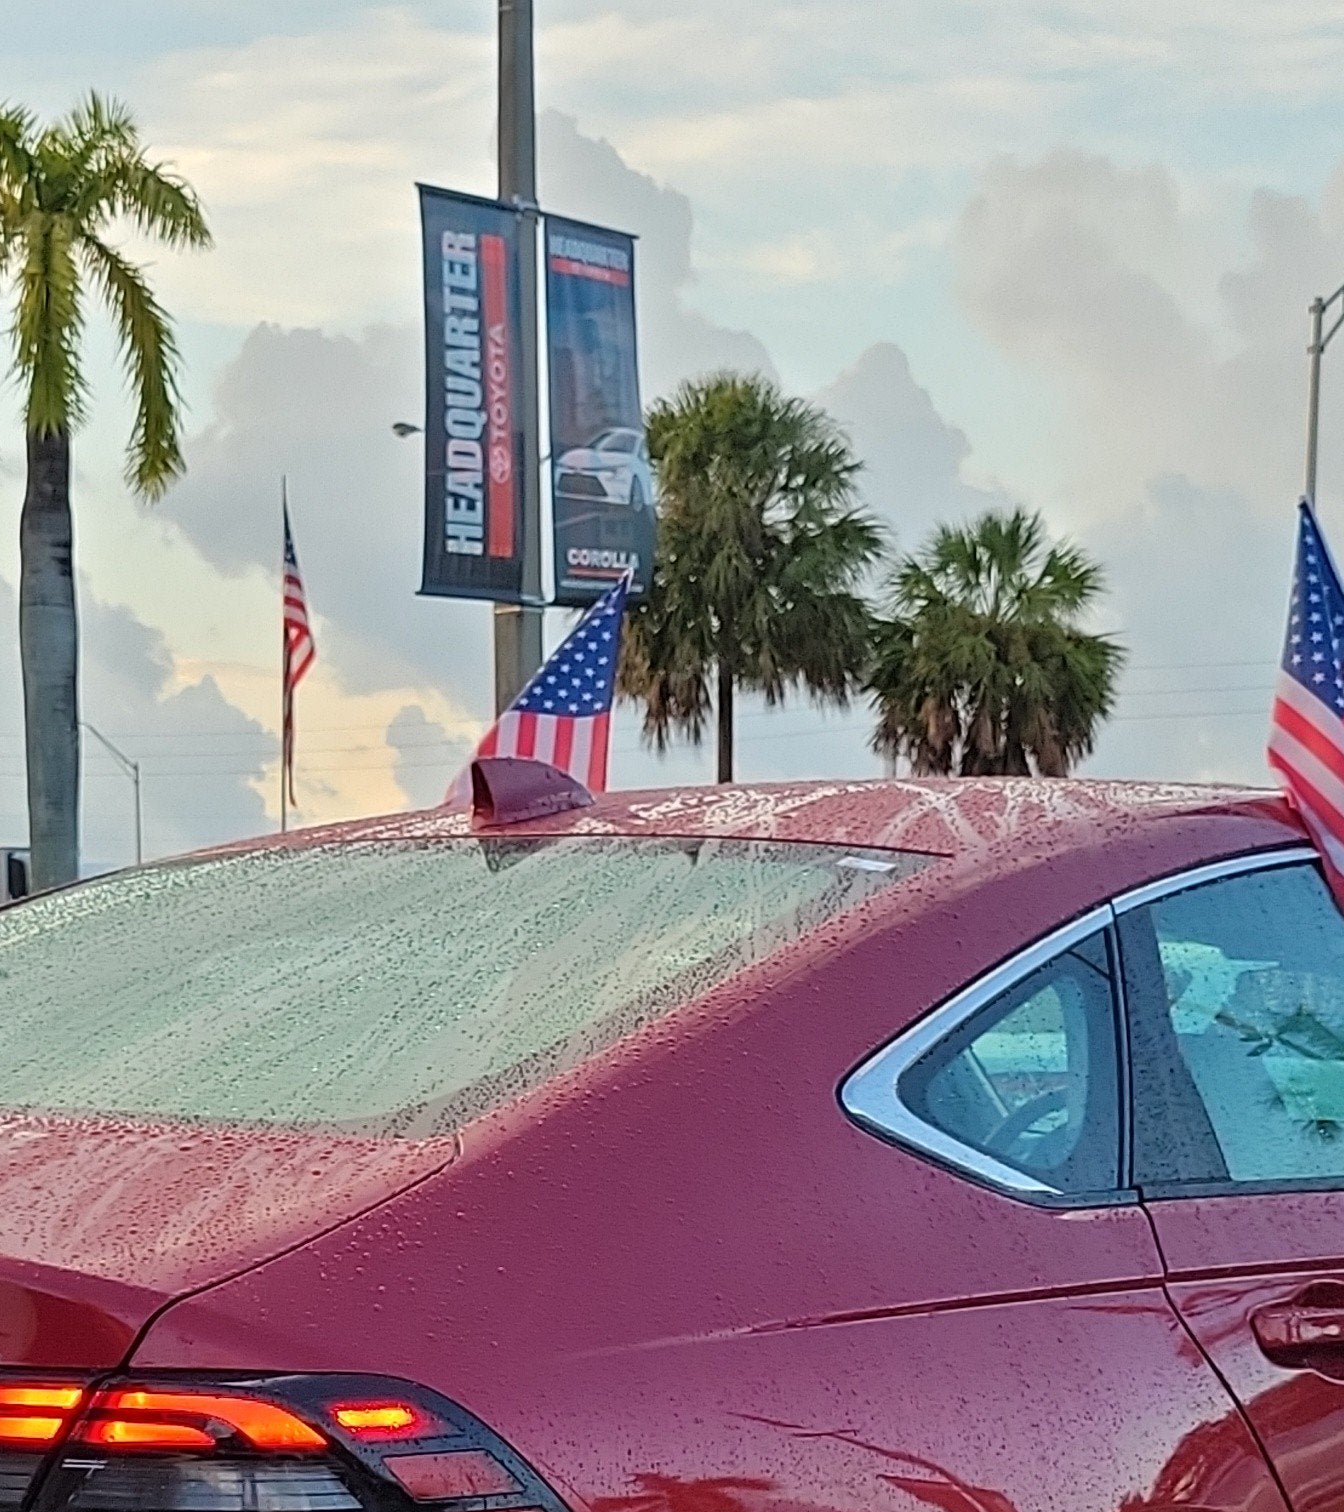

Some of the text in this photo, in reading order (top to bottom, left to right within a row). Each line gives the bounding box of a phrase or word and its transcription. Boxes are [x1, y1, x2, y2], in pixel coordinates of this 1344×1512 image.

[441, 230, 487, 556] HEADQUARTER
[488, 324, 509, 446] TOYOTA
[567, 548, 640, 570] COROLLA
